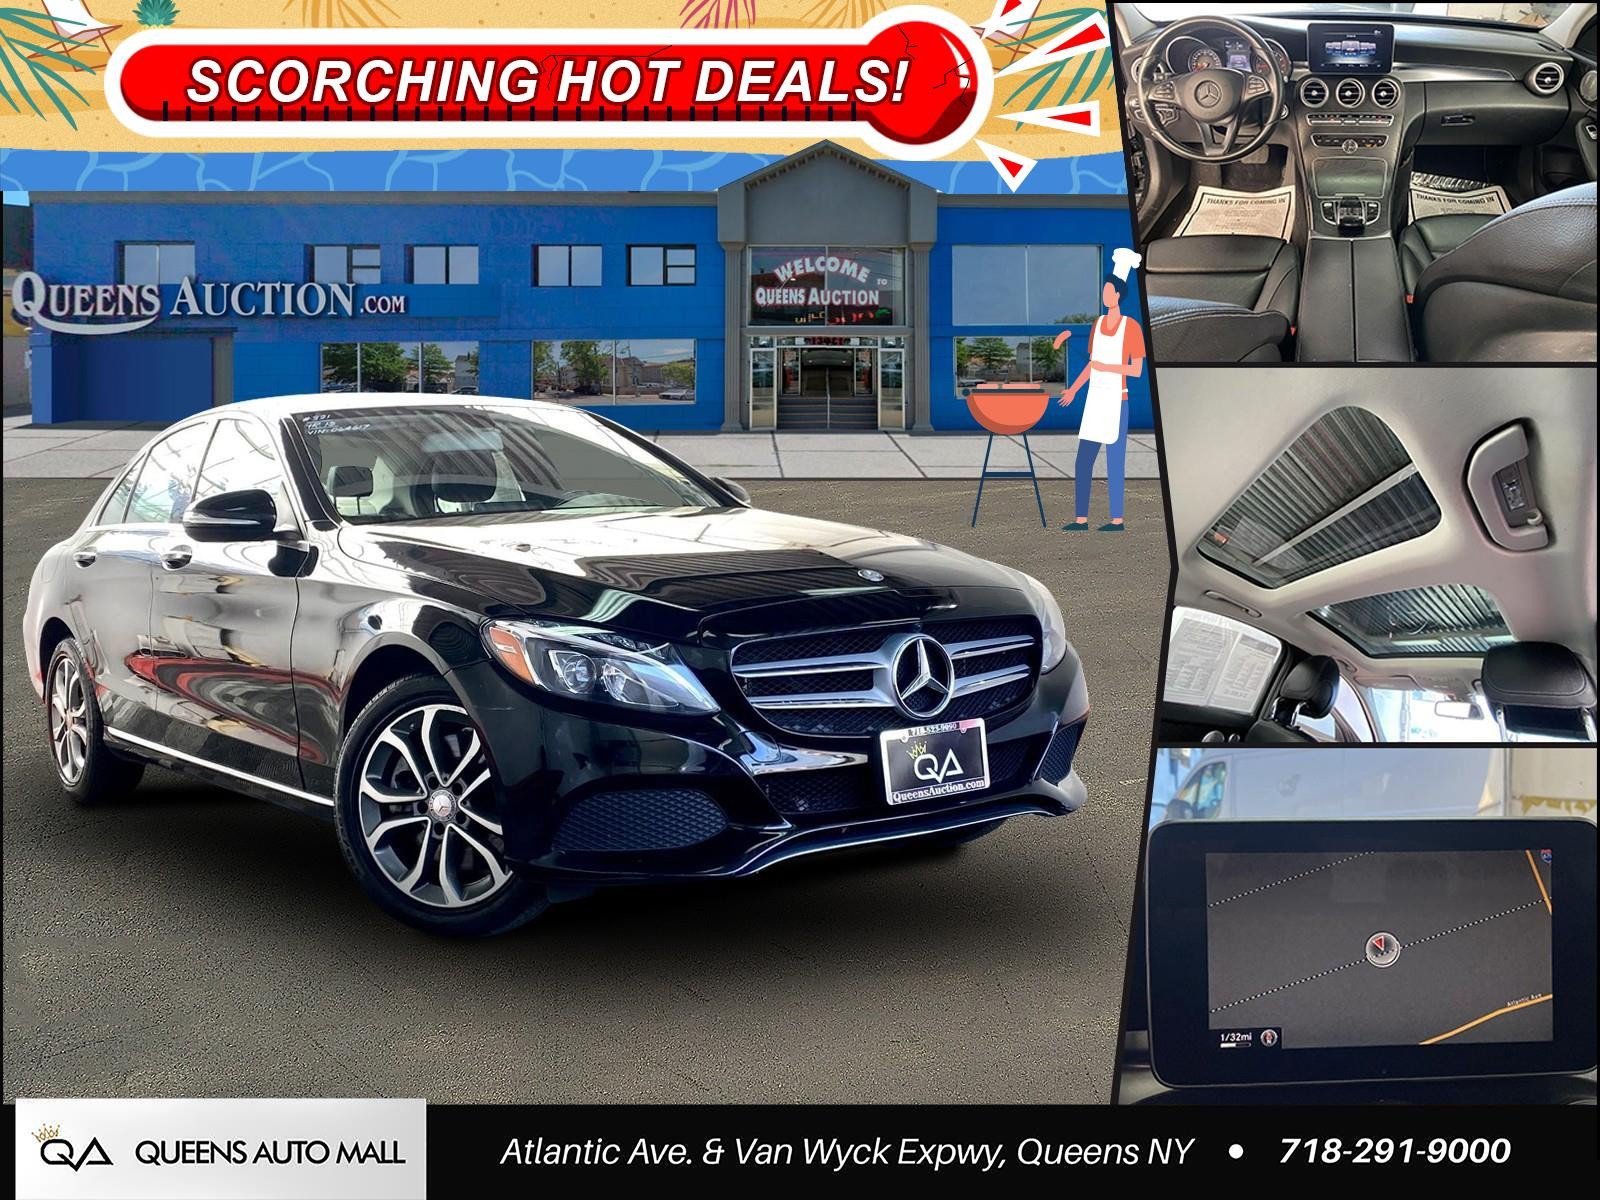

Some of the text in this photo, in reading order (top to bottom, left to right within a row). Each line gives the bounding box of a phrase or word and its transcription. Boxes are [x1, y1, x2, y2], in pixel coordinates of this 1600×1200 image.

[773, 255, 888, 286] WELCOME TO
[12, 271, 160, 335] QUEENS
[755, 286, 880, 307] QUEENS AUCTION
[913, 748, 964, 784] QA
[893, 778, 985, 802] QueensAuction.com
[1220, 1032, 1252, 1042] 1/32mi
